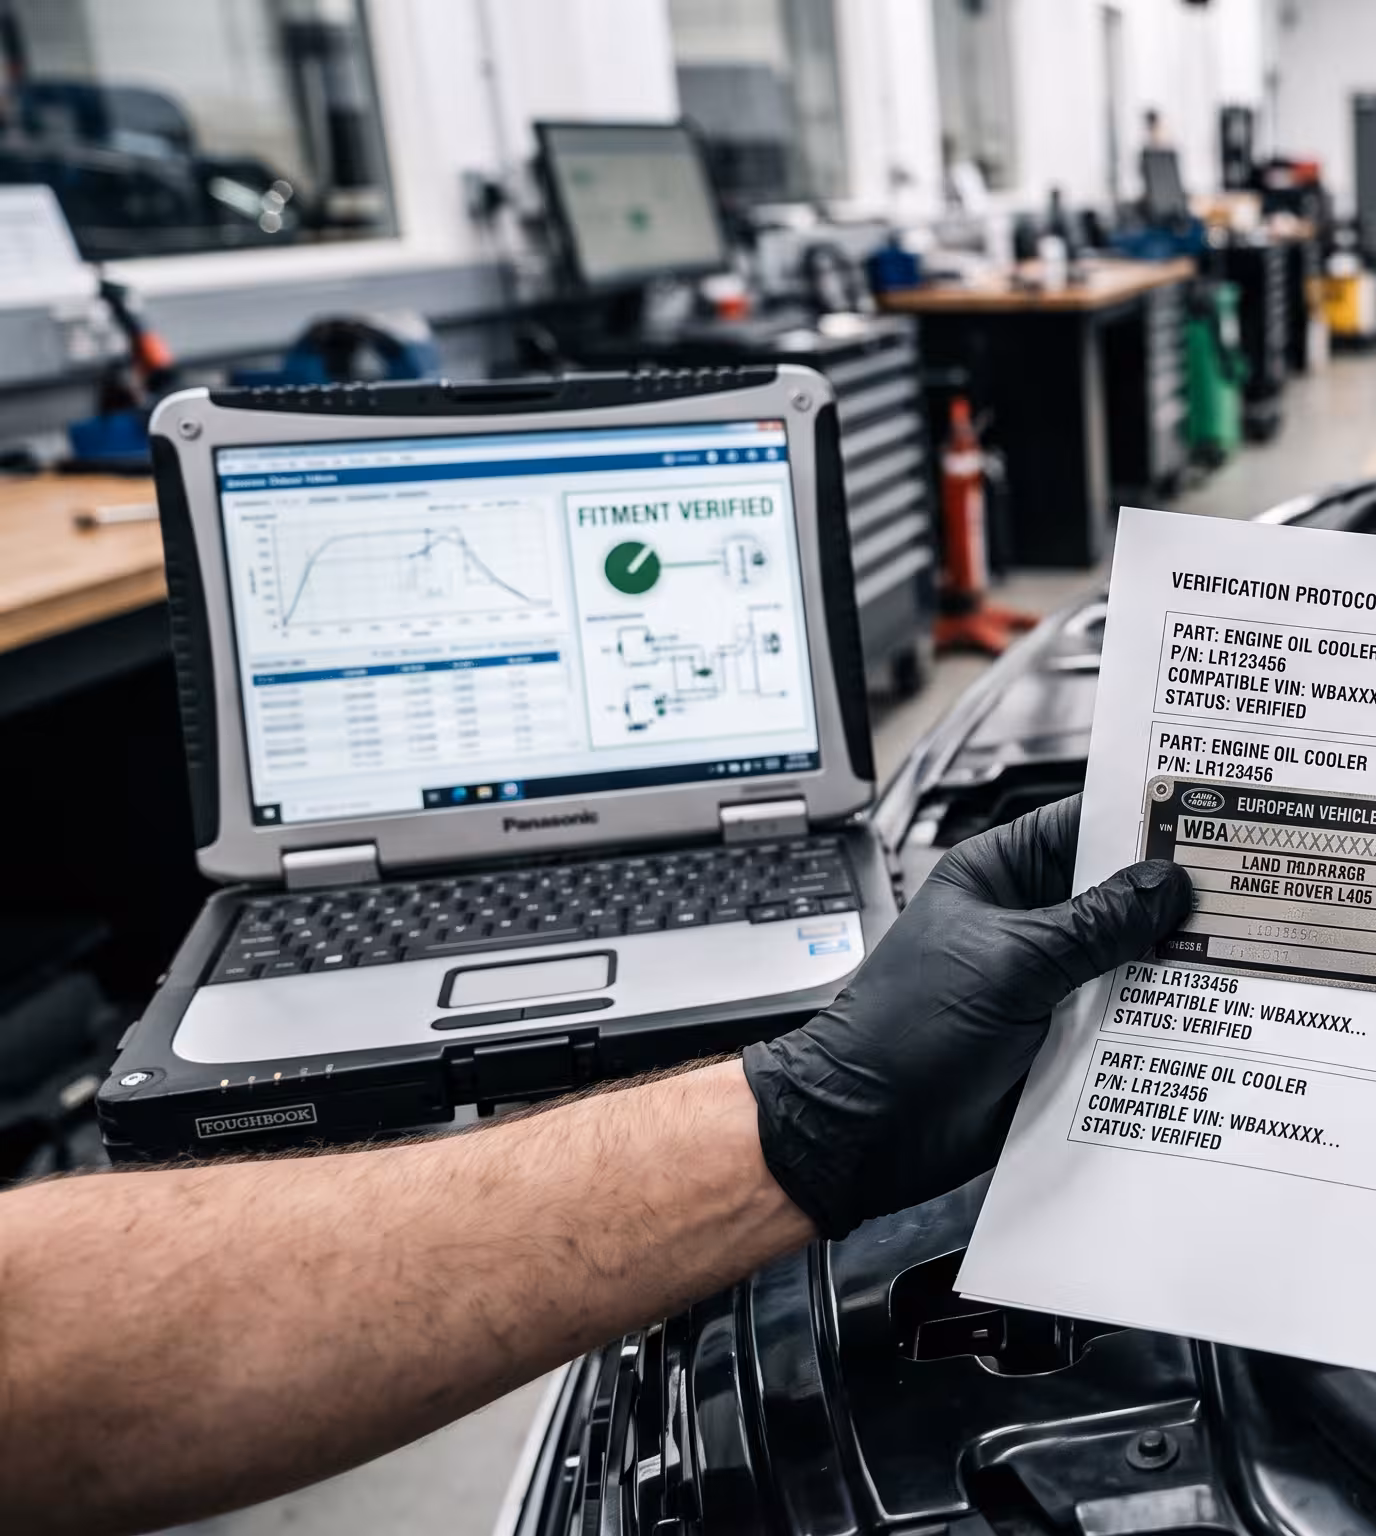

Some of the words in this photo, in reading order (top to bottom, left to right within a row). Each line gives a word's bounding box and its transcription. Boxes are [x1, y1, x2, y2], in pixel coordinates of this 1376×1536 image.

[577, 502, 670, 528] FITMENT
[677, 496, 773, 521] VERIFIED
[1172, 571, 1290, 602] VERIFICATION
[1173, 622, 1219, 643] PART:
[1224, 628, 1284, 650] ENGINE
[1287, 635, 1313, 654] OIL
[1170, 644, 1204, 663] P/N:
[1208, 648, 1287, 673] LR123456
[1168, 666, 1270, 693] COMPATIBLE
[1274, 678, 1306, 697] VIN:
[1165, 688, 1231, 711] STATUS:
[1236, 696, 1307, 719] VERIFIED
[1159, 732, 1207, 753] PART:
[1211, 738, 1270, 760] ENGINE
[1274, 745, 1299, 764] OIL
[1304, 749, 1368, 772] COOLER
[1156, 754, 1191, 774] P/N:
[1194, 758, 1274, 783] LR123456
[502, 808, 599, 833] Panasonic
[1237, 797, 1315, 820] EUROPEAN
[1159, 823, 1173, 832] VIN
[1241, 855, 1281, 873] LAND
[1230, 875, 1280, 895] RANGE
[1283, 881, 1334, 901] ROVER
[1337, 887, 1373, 905] L405
[1124, 964, 1158, 984] P/N:
[1161, 969, 1239, 995] LR133456
[1113, 1007, 1178, 1031] STATUS:
[1182, 1016, 1253, 1040] VERIFIED
[1119, 986, 1220, 1014] COMPATIBLE
[1224, 999, 1255, 1019] VIN:
[1260, 1004, 1366, 1036] WBAXXXXX...
[1094, 1072, 1128, 1092] P/N:
[1130, 1077, 1209, 1103] LR123456
[1100, 1050, 1146, 1072] PART:
[1148, 1057, 1209, 1080] ENGINE
[1211, 1066, 1236, 1085] OIL
[1241, 1070, 1308, 1096] COOLER
[201, 1109, 312, 1134] TOUGHBOOK
[1081, 1115, 1146, 1140] STATUS:
[1151, 1125, 1222, 1150] VERIFIED
[1088, 1094, 1189, 1123] COMPATIBLE
[1193, 1108, 1225, 1128] VIN:
[1230, 1113, 1340, 1148] WBAXXXXX...
